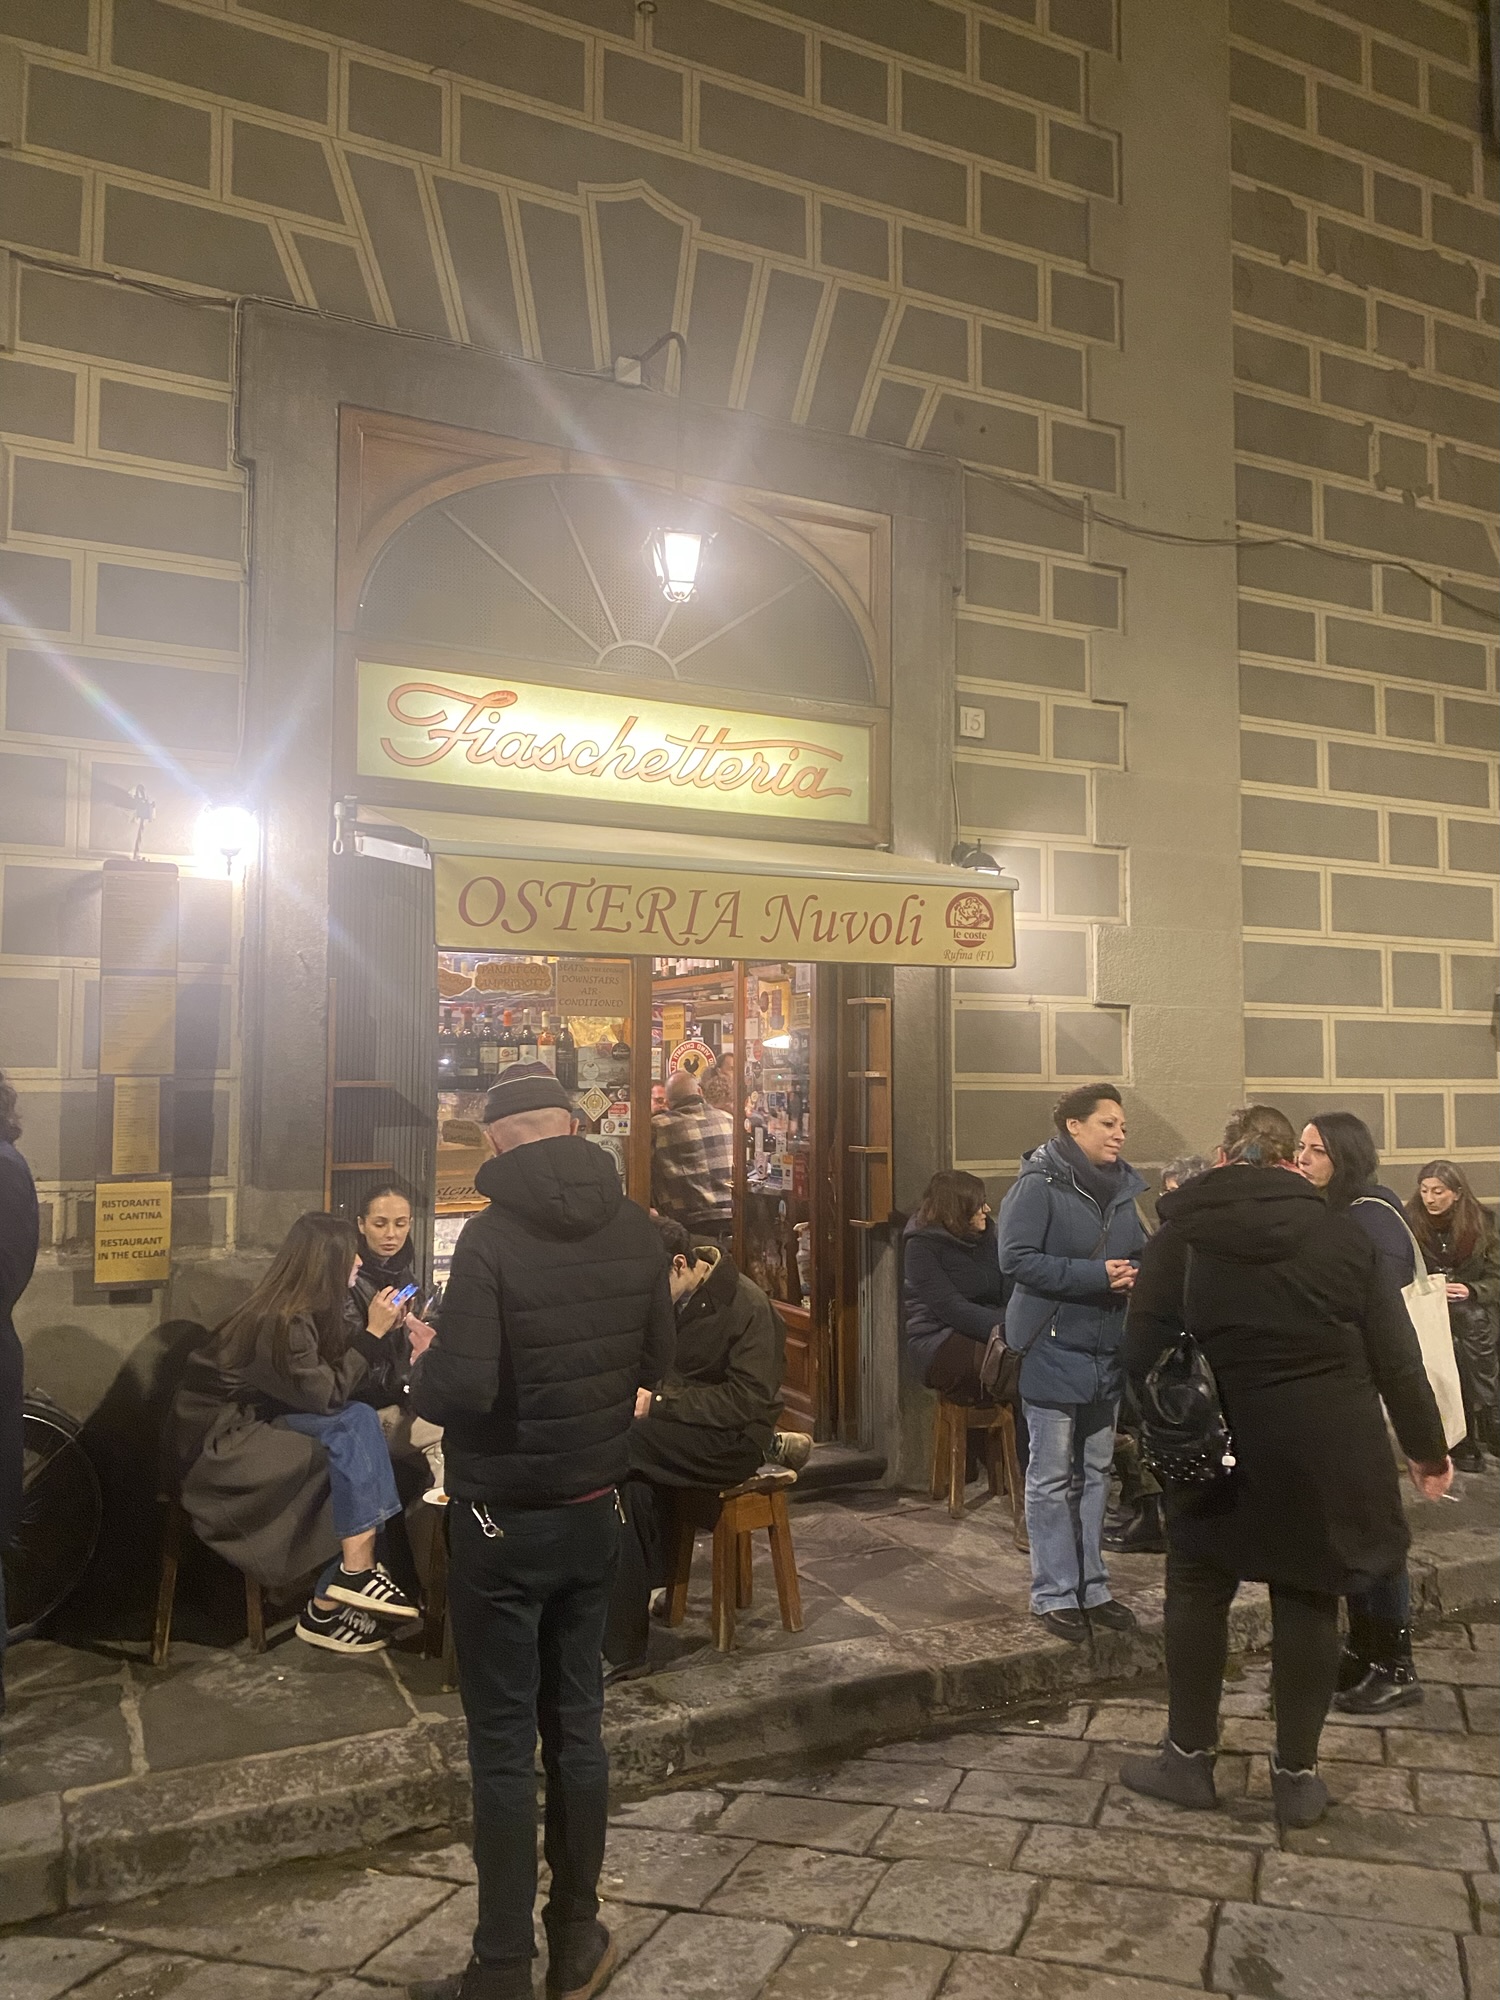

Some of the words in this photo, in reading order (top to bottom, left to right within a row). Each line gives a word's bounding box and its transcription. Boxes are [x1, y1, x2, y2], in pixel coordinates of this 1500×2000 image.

[964, 712, 981, 732] 15
[380, 682, 852, 799] Fiaschetteria
[458, 876, 744, 946] OSTERIA
[760, 894, 926, 946] Nuvoli
[953, 928, 962, 939] le
[963, 931, 988, 940] coste
[943, 948, 973, 963] Rufina
[975, 950, 995, 962] (FI)
[558, 963, 584, 973] SEATS
[561, 974, 621, 986] DOWNSTAIRS
[558, 997, 624, 1008] CONDITIONED
[101, 1198, 161, 1209] RISTORANTE
[103, 1213, 114, 1222] IN
[118, 1211, 163, 1221] CANTINA
[100, 1236, 163, 1248] RESTAURANT
[97, 1252, 109, 1261] IN
[111, 1250, 129, 1260] THE
[131, 1249, 167, 1260] CELLAR
